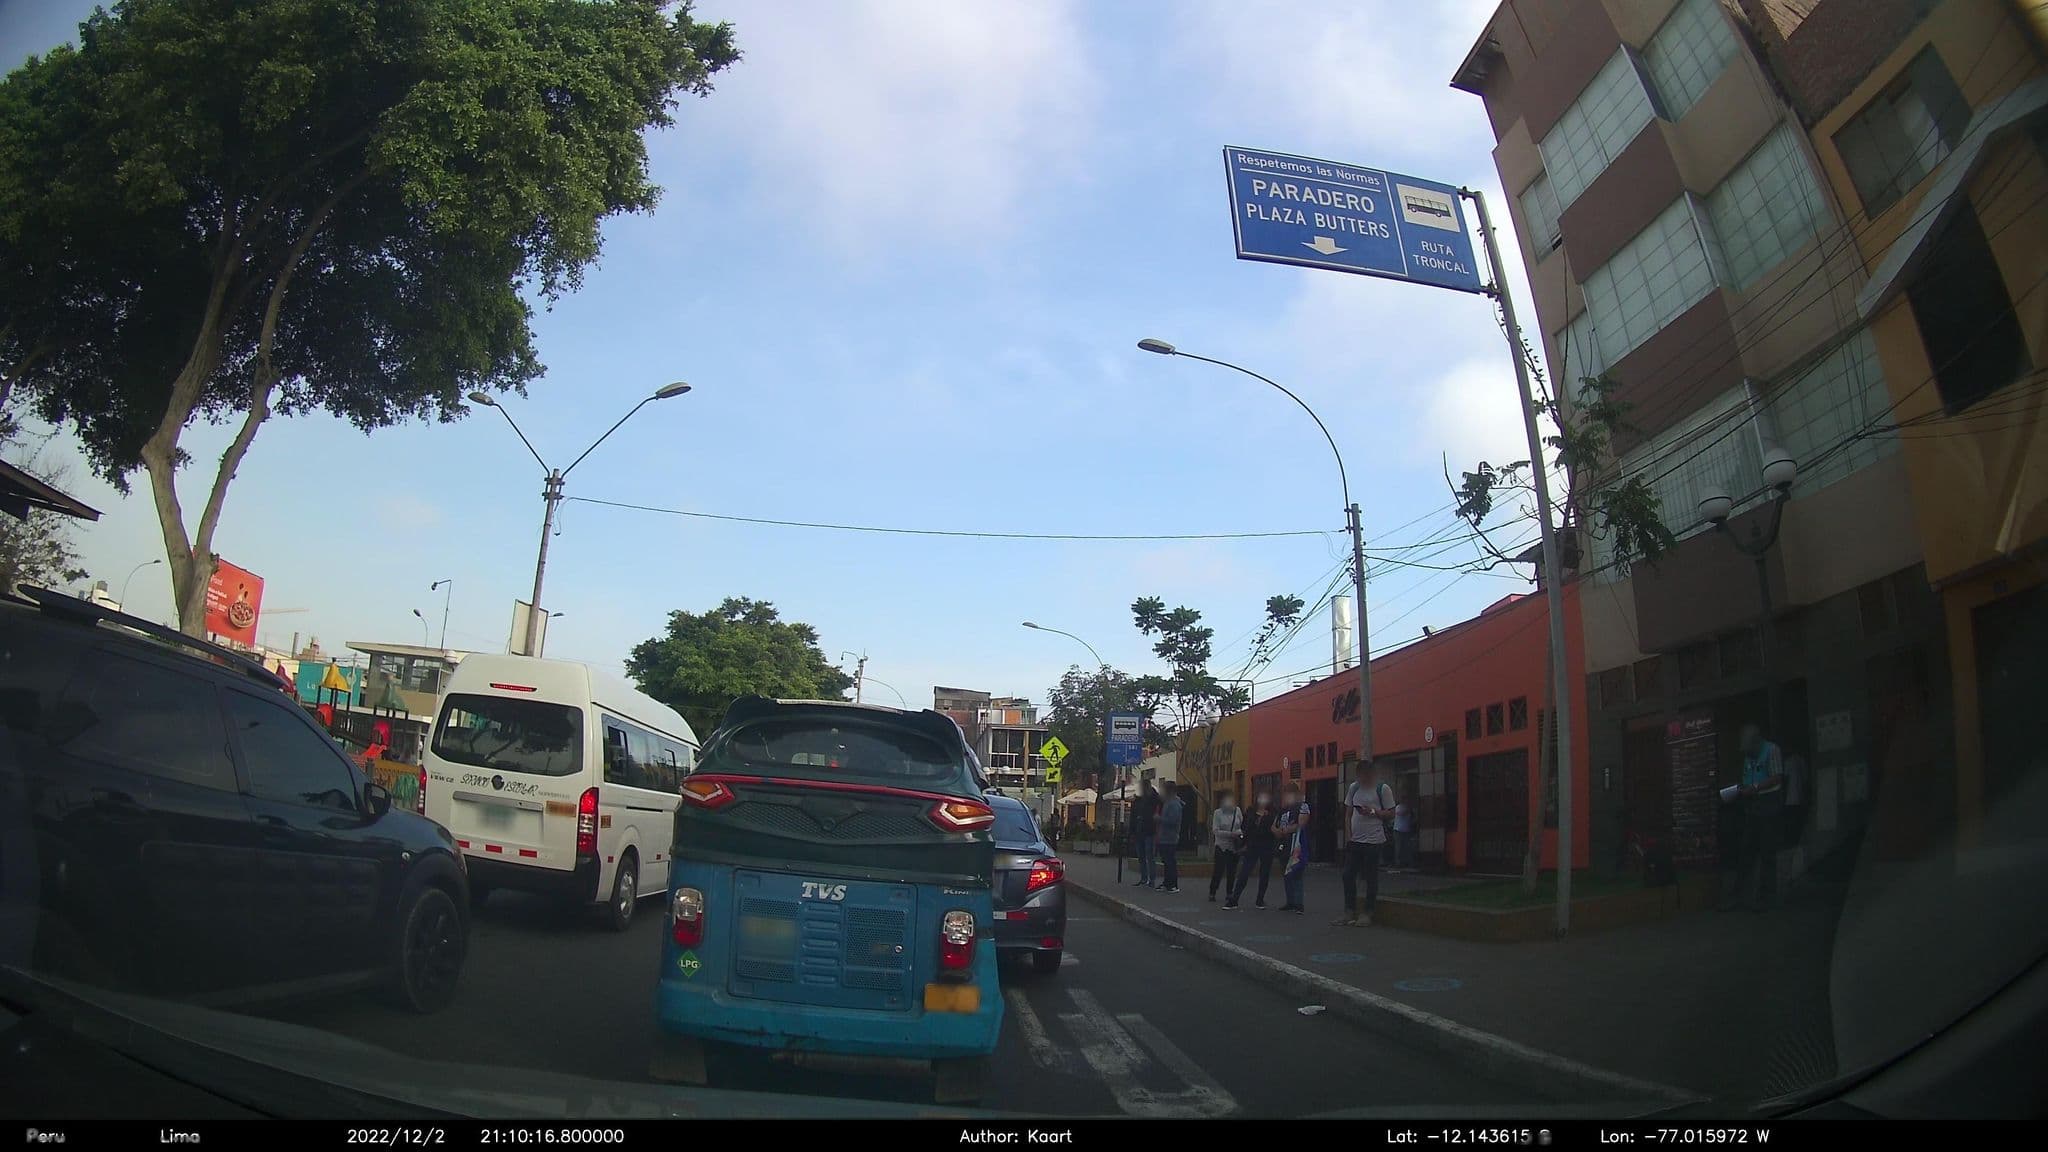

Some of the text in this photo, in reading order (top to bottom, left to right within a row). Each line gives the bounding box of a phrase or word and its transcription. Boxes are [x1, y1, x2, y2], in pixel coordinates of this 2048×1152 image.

[1237, 153, 1380, 186] Respetemos las Normas
[1252, 179, 1375, 214] PARADERO
[1246, 203, 1390, 239] PLAZA BUTTERS
[1421, 240, 1455, 257] RUTA
[1413, 254, 1470, 275] TRONCAL
[801, 881, 848, 902] TVS
[679, 958, 699, 969] LPG
